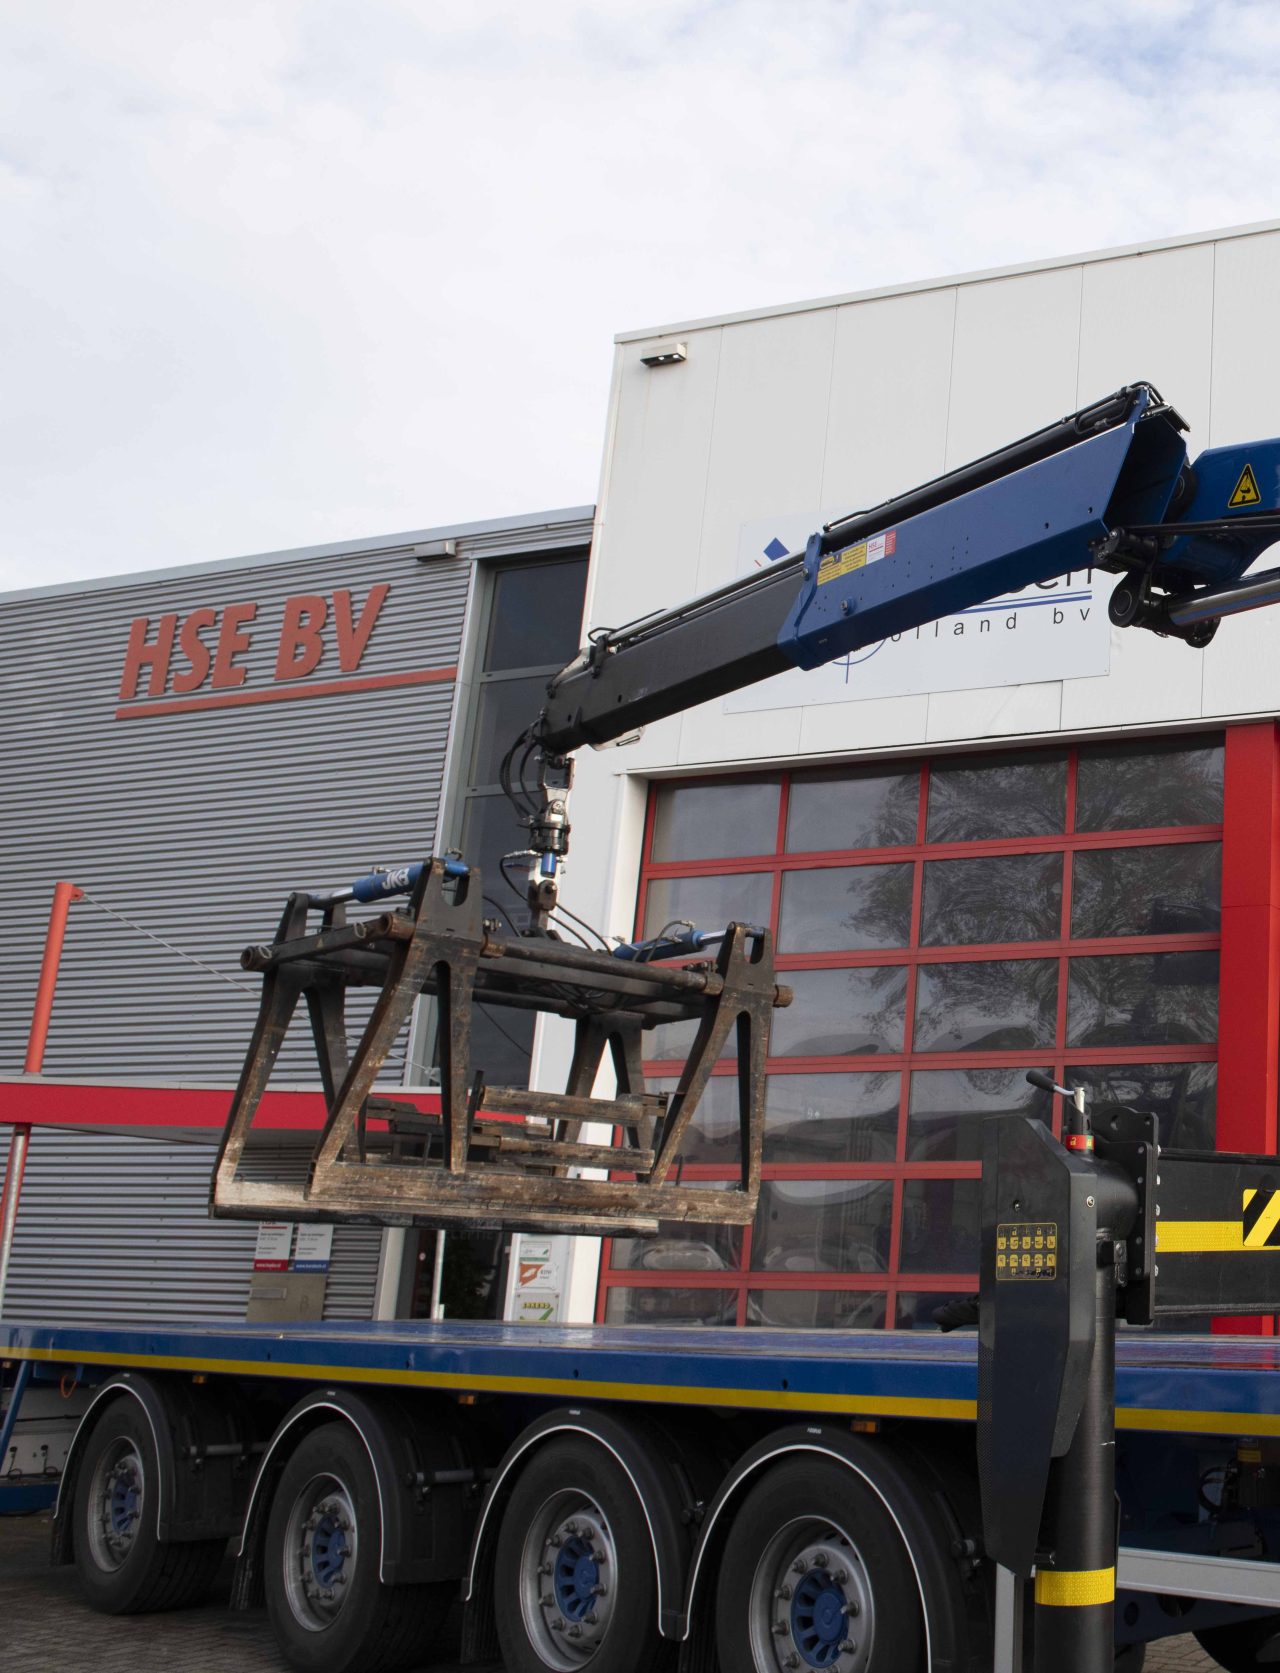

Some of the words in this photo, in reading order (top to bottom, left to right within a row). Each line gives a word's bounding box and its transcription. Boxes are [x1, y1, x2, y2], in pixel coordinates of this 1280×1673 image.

[119, 602, 257, 699] HSE
[274, 583, 391, 681] BV
[891, 612, 1017, 642] olland
[1053, 607, 1091, 625] bv
